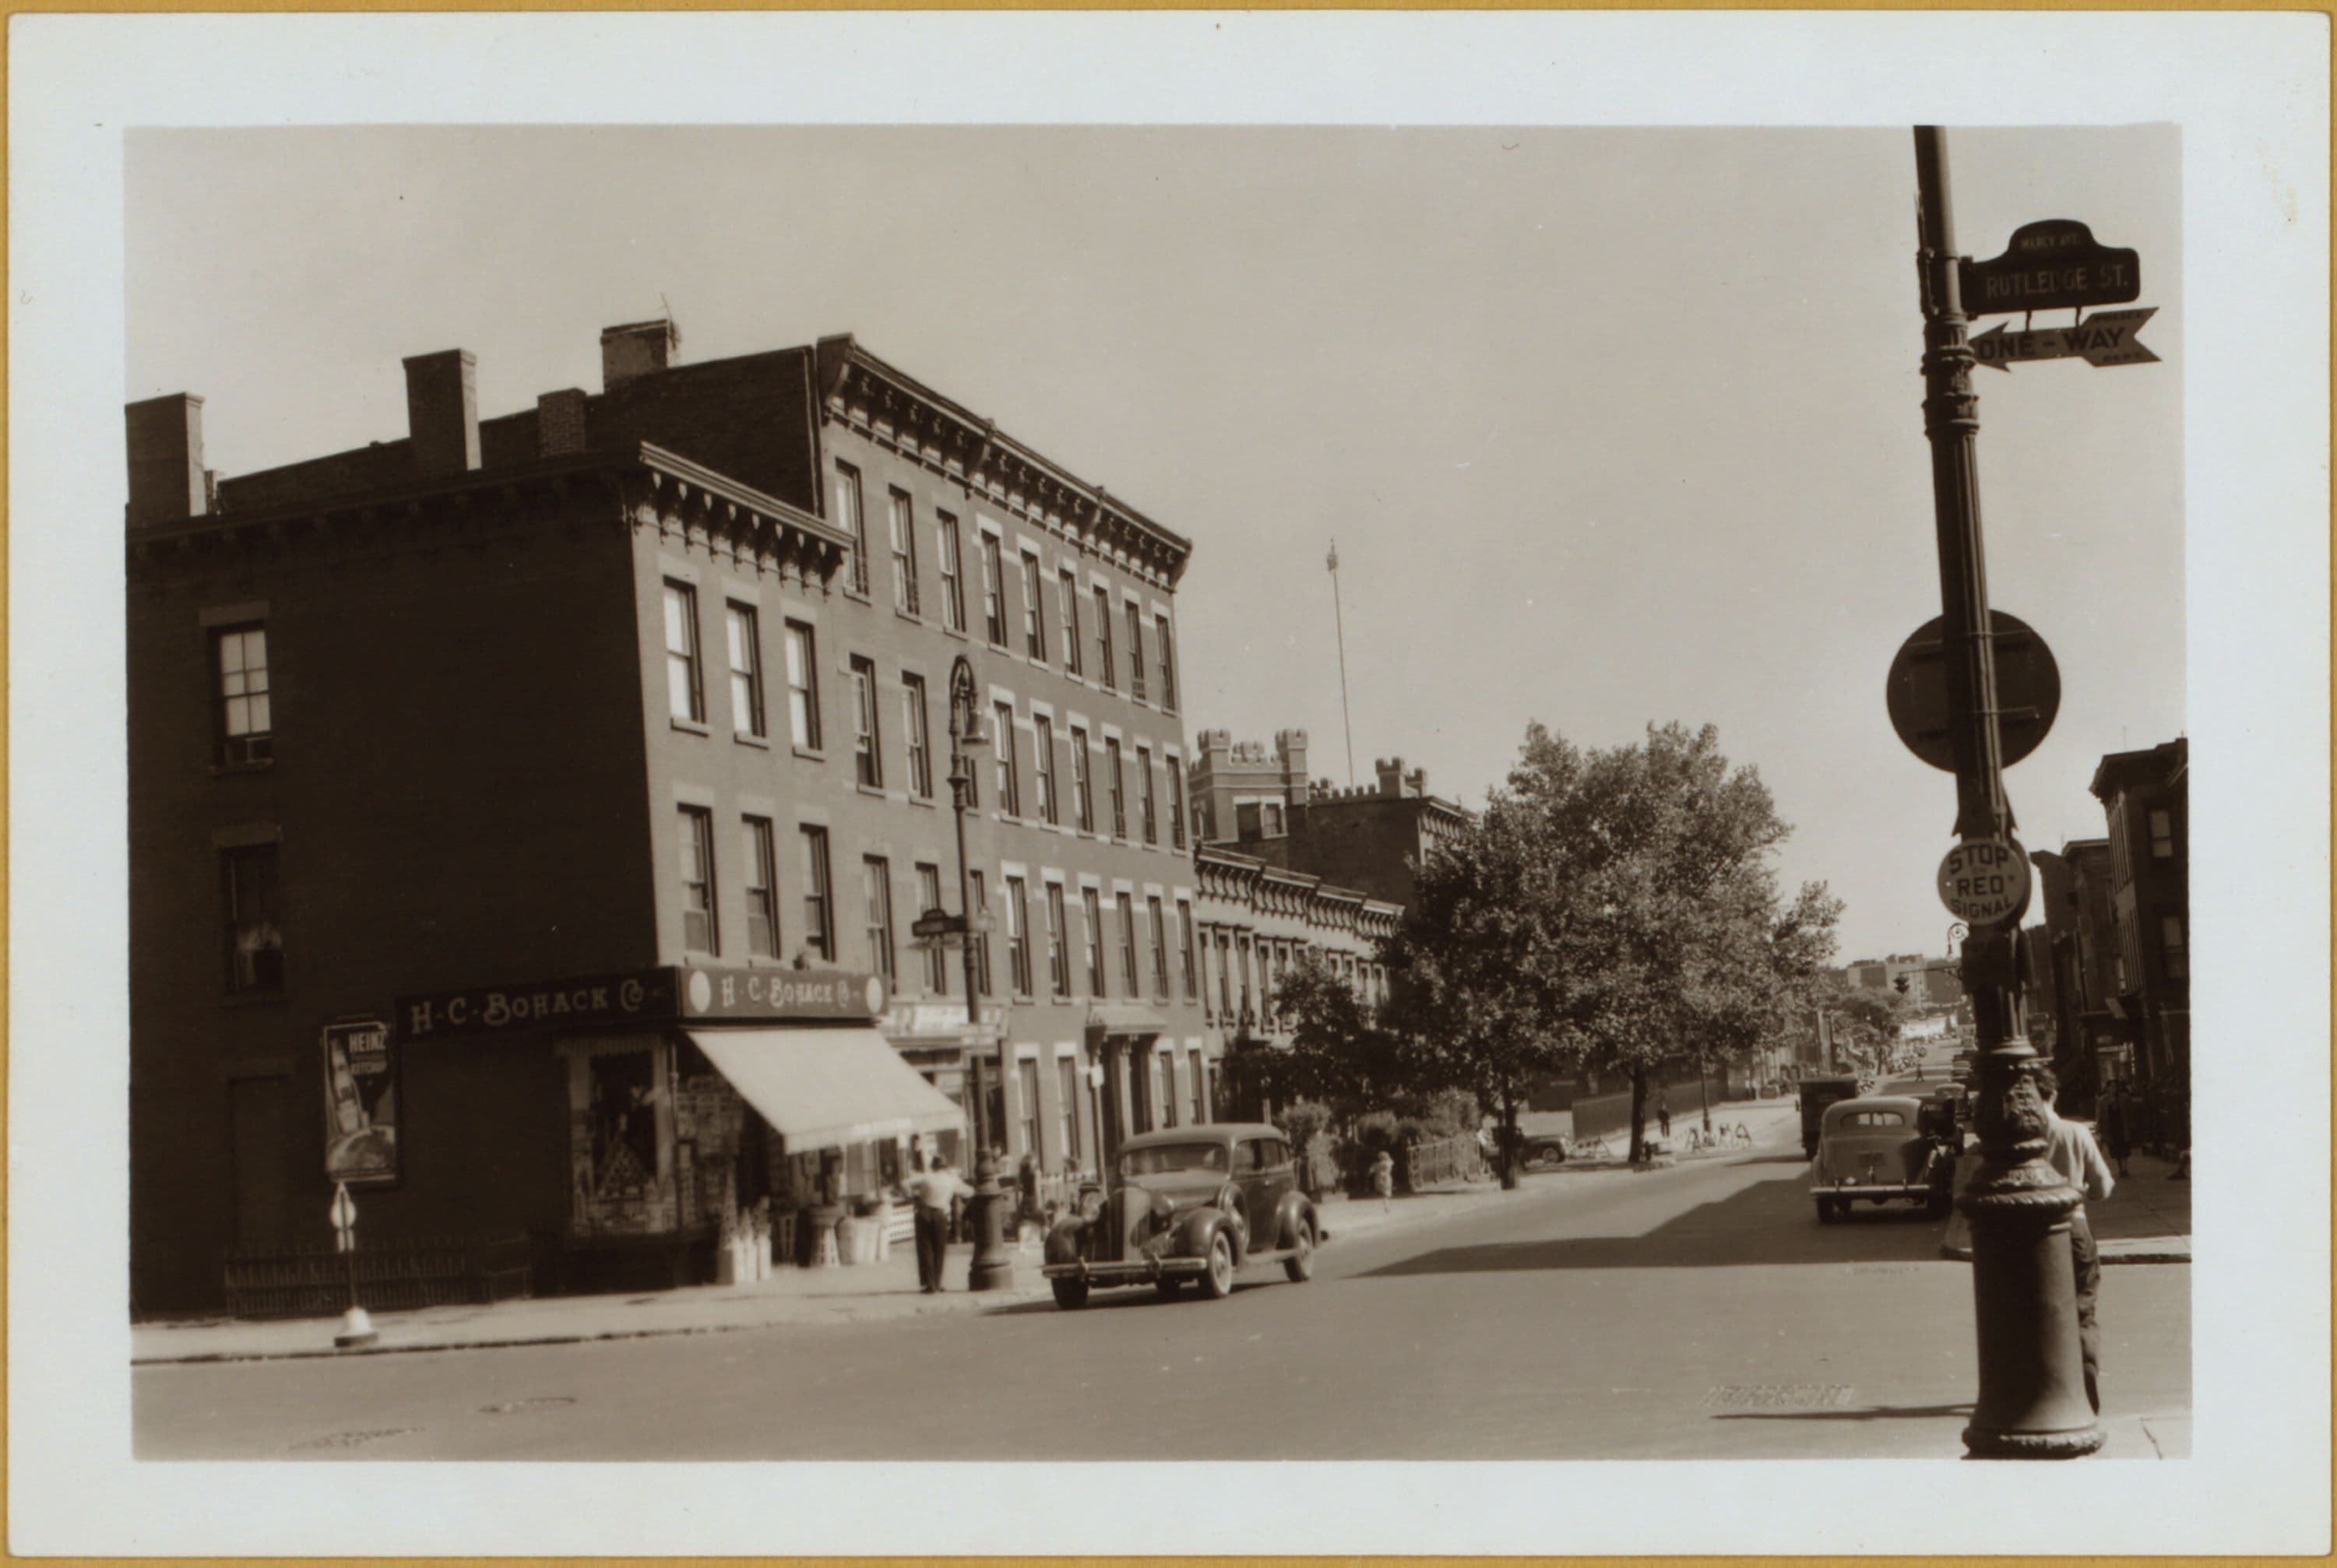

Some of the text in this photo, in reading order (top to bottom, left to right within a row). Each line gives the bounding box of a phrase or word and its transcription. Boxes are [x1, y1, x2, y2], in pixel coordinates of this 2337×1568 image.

[1986, 264, 2129, 297] RUTLEDGE ST.
[1948, 844, 2008, 875] STOP
[1957, 875, 2004, 897] RED
[1950, 895, 2014, 918] SIGNAL
[349, 1032, 387, 1053] HEINZ
